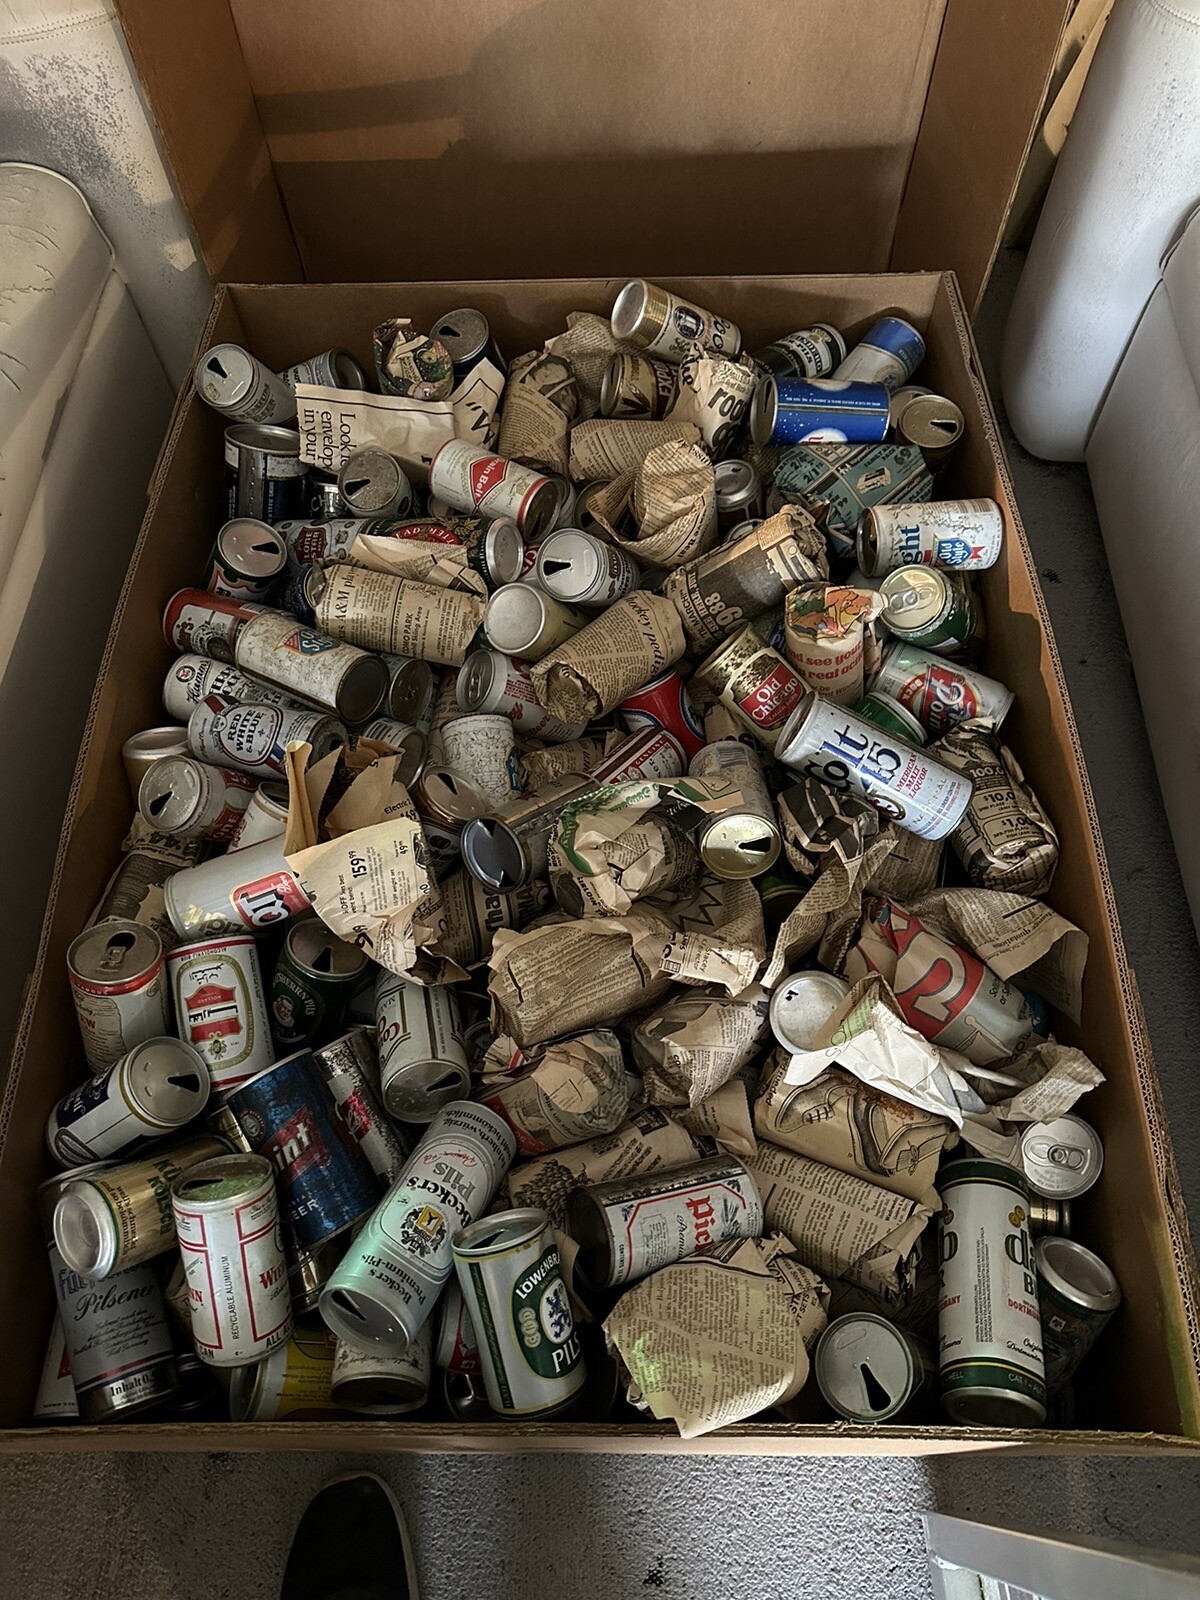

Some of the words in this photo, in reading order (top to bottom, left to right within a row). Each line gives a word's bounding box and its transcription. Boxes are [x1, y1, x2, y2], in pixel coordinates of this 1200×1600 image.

[304, 408, 317, 422] in
[340, 412, 356, 448] Look
[303, 423, 318, 464] your
[937, 542, 952, 562] Old
[949, 540, 965, 565] Style
[335, 590, 350, 622] A&M
[624, 595, 651, 630] hockey
[402, 613, 414, 634] PARK
[401, 634, 411, 654] COMO
[806, 656, 832, 667] see
[809, 667, 840, 680] real
[751, 677, 799, 721] Chicago
[755, 677, 784, 703] Old
[227, 713, 242, 740] RED
[236, 709, 256, 752] WHITE
[247, 711, 264, 745] BLUE
[804, 724, 869, 793] Colt
[861, 741, 902, 791] 45
[905, 765, 921, 790] MALT
[908, 767, 929, 799] LIQUOR
[304, 1000, 315, 1017] PILS
[115, 1185, 130, 1207] weil's
[432, 1161, 478, 1201] Pils
[147, 1175, 173, 1235] KÖLSCH
[406, 1174, 473, 1229] Becker's
[220, 1255, 235, 1296] ALUMINUM
[360, 1252, 427, 1307] Premium-Pils
[367, 1268, 414, 1306] Becker's
[74, 1283, 155, 1321] Pilsener
[226, 1294, 241, 1340] RECYCLABLE
[265, 1335, 282, 1349] ALL
[551, 1331, 581, 1373] PILS
[109, 1377, 144, 1398] Inhalt
